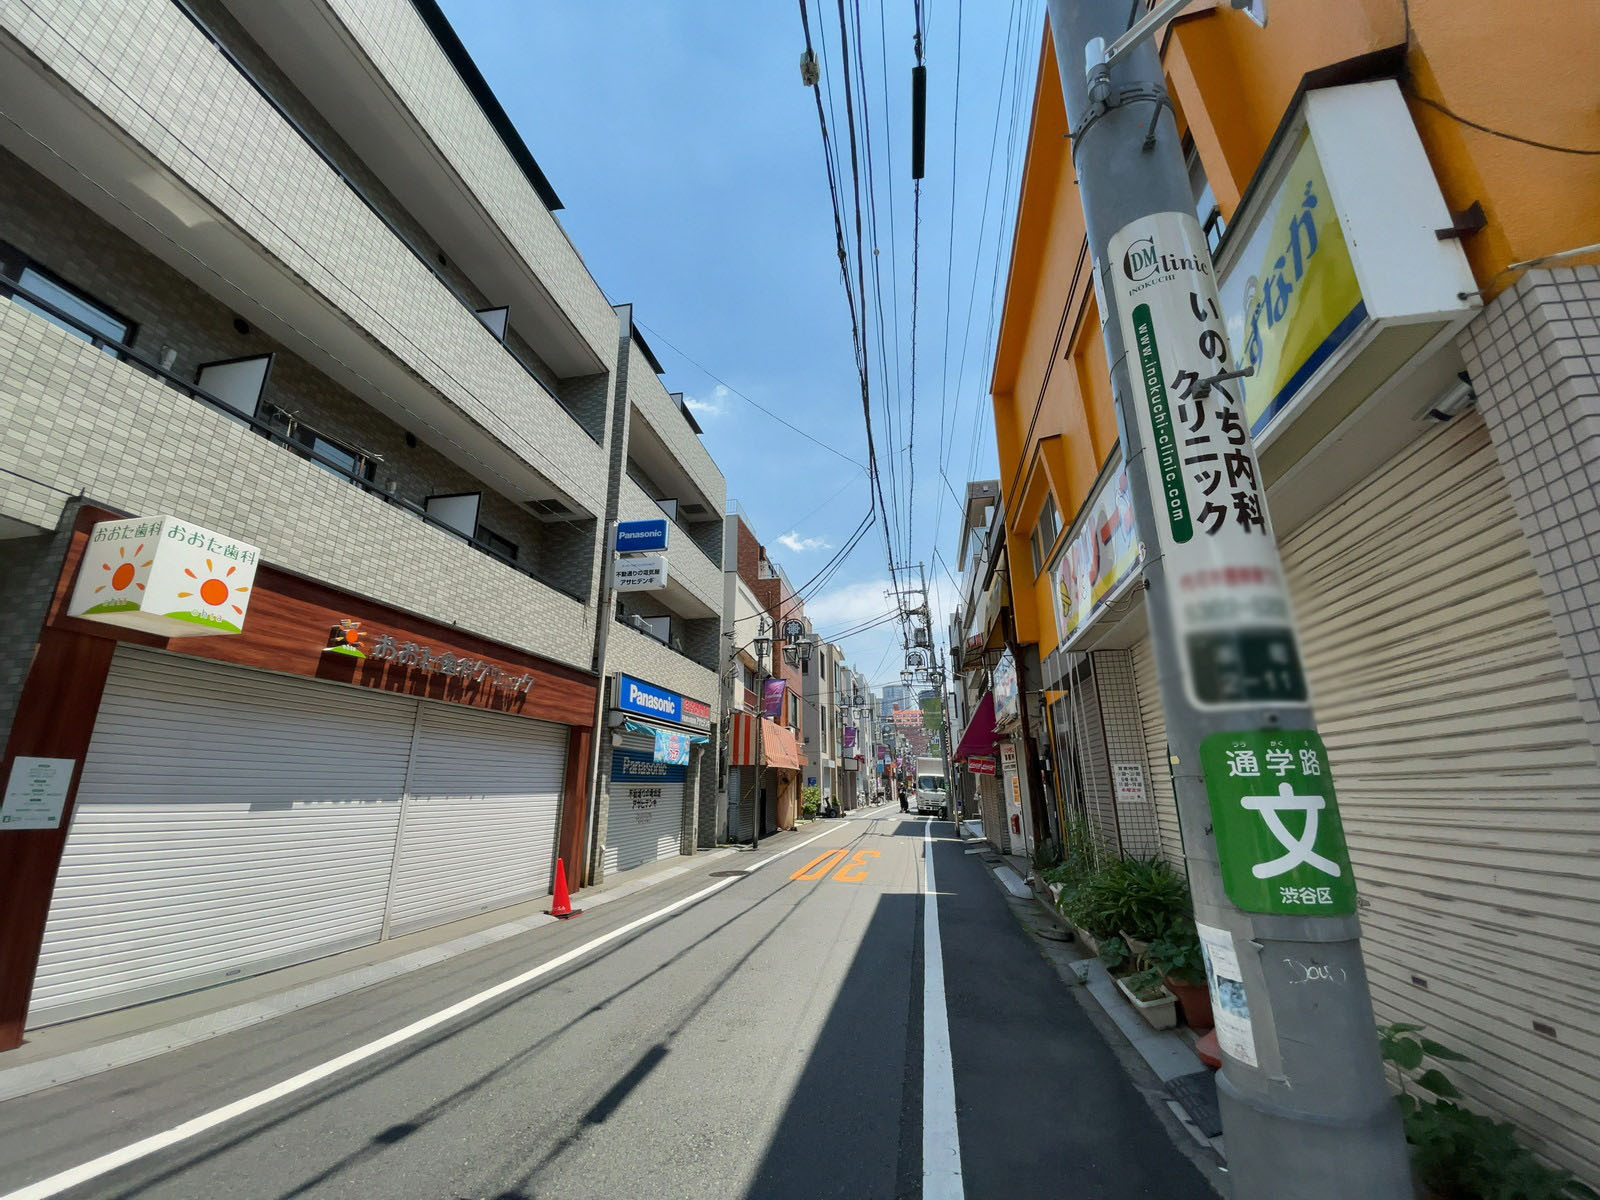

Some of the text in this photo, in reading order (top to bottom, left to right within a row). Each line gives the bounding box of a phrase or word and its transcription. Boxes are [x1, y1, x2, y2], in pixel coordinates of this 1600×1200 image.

[1129, 274, 1176, 296] INOKUCHI
[1138, 323, 1184, 522] www.inokuchi-clinic.com
[1190, 291, 1267, 535] いのくち内科
[1170, 369, 1228, 536] クリニック
[94, 522, 162, 543] おおた歯科
[168, 524, 257, 566] おおた歯科
[618, 529, 662, 540] Panasonic
[372, 634, 537, 694] おおた歯科クリニック
[629, 683, 675, 715] Panasonic
[1225, 748, 1321, 777] 通学路
[1240, 781, 1341, 879] 文
[1279, 886, 1334, 905] 渋谷区
